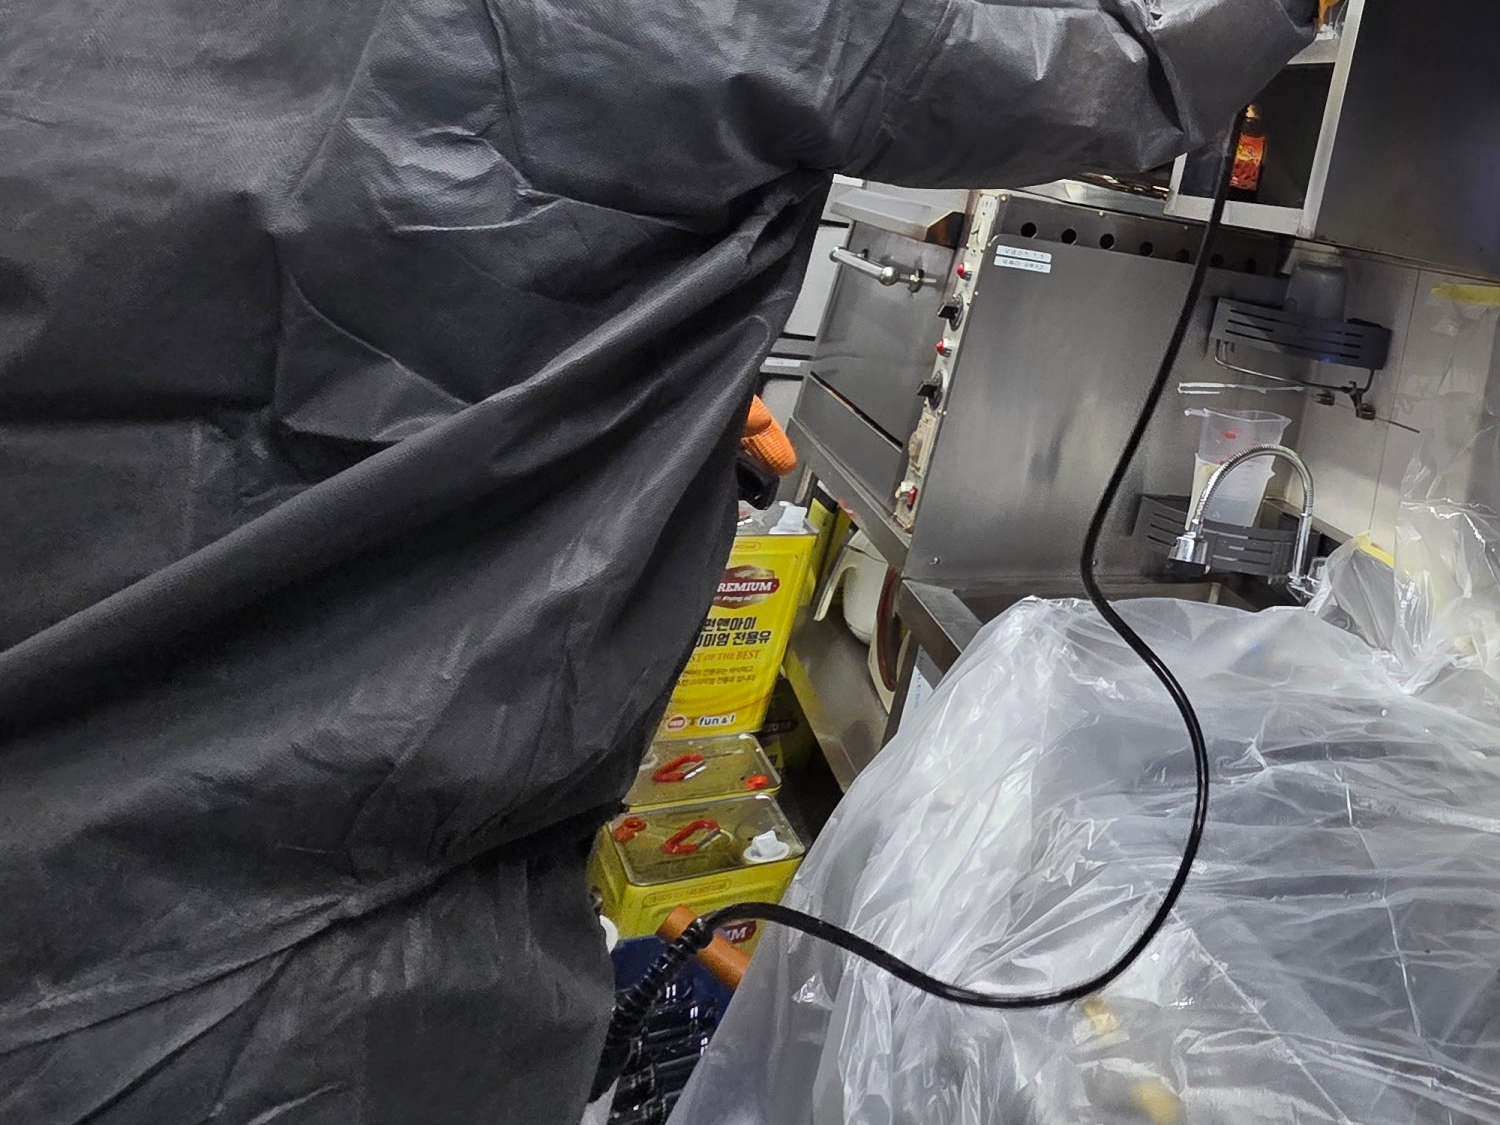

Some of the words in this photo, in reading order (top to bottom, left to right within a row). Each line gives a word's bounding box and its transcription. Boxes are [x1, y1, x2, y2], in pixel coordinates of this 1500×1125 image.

[717, 581, 772, 593] REMIUM
[736, 649, 761, 660] BEST
[699, 716, 719, 726] fun
